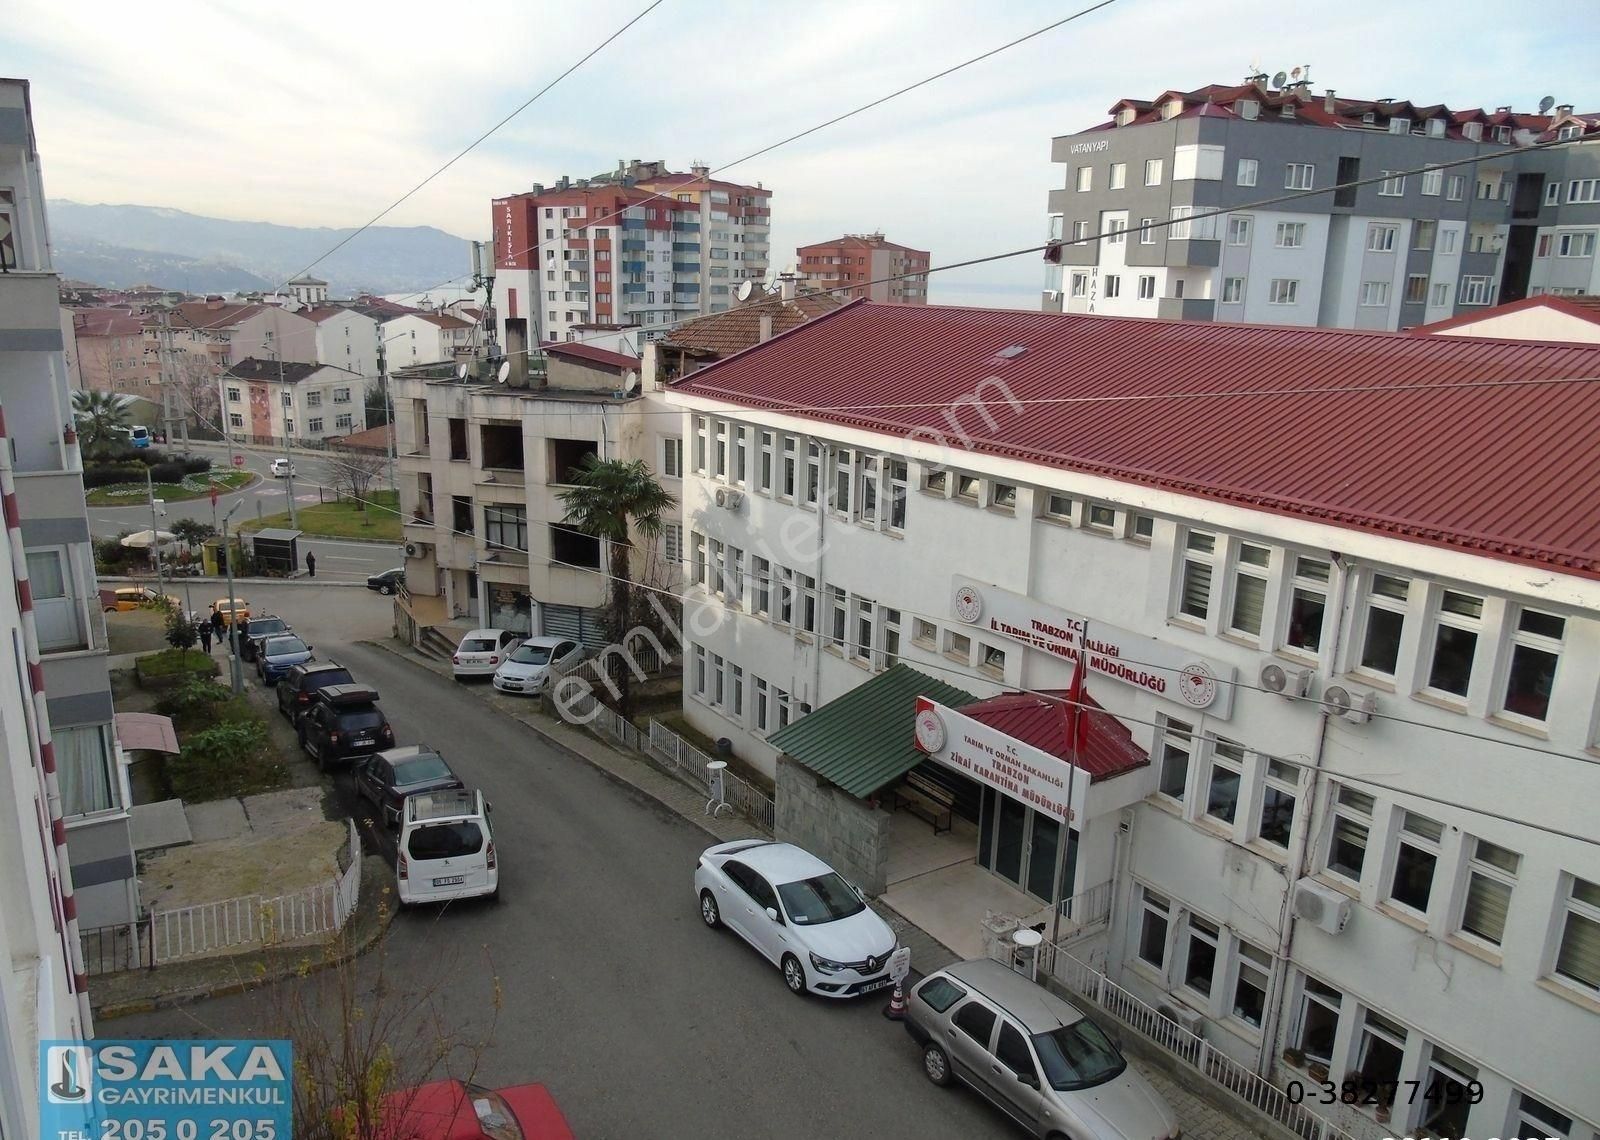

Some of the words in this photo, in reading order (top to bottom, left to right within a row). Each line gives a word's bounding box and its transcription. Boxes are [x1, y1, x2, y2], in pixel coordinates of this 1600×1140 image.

[1031, 619, 1073, 643] TRABZON
[1066, 618, 1083, 632] T.C.
[990, 617, 999, 631] İL
[1000, 622, 1031, 643] TARIM
[1032, 635, 1045, 649] VE
[1046, 641, 1081, 662] ORMA
[1090, 656, 1166, 693] MÜDÜRLÜĞÜ
[964, 735, 984, 751] TARIM
[985, 745, 994, 755] VE
[995, 749, 1021, 769] ORMAN
[1023, 763, 1063, 789] BAKANLIĞI
[1006, 745, 1019, 756] T.C.
[950, 751, 971, 770] ZİRAİ
[974, 763, 1019, 794] KARANTİNA
[992, 759, 1030, 785] TRABZON
